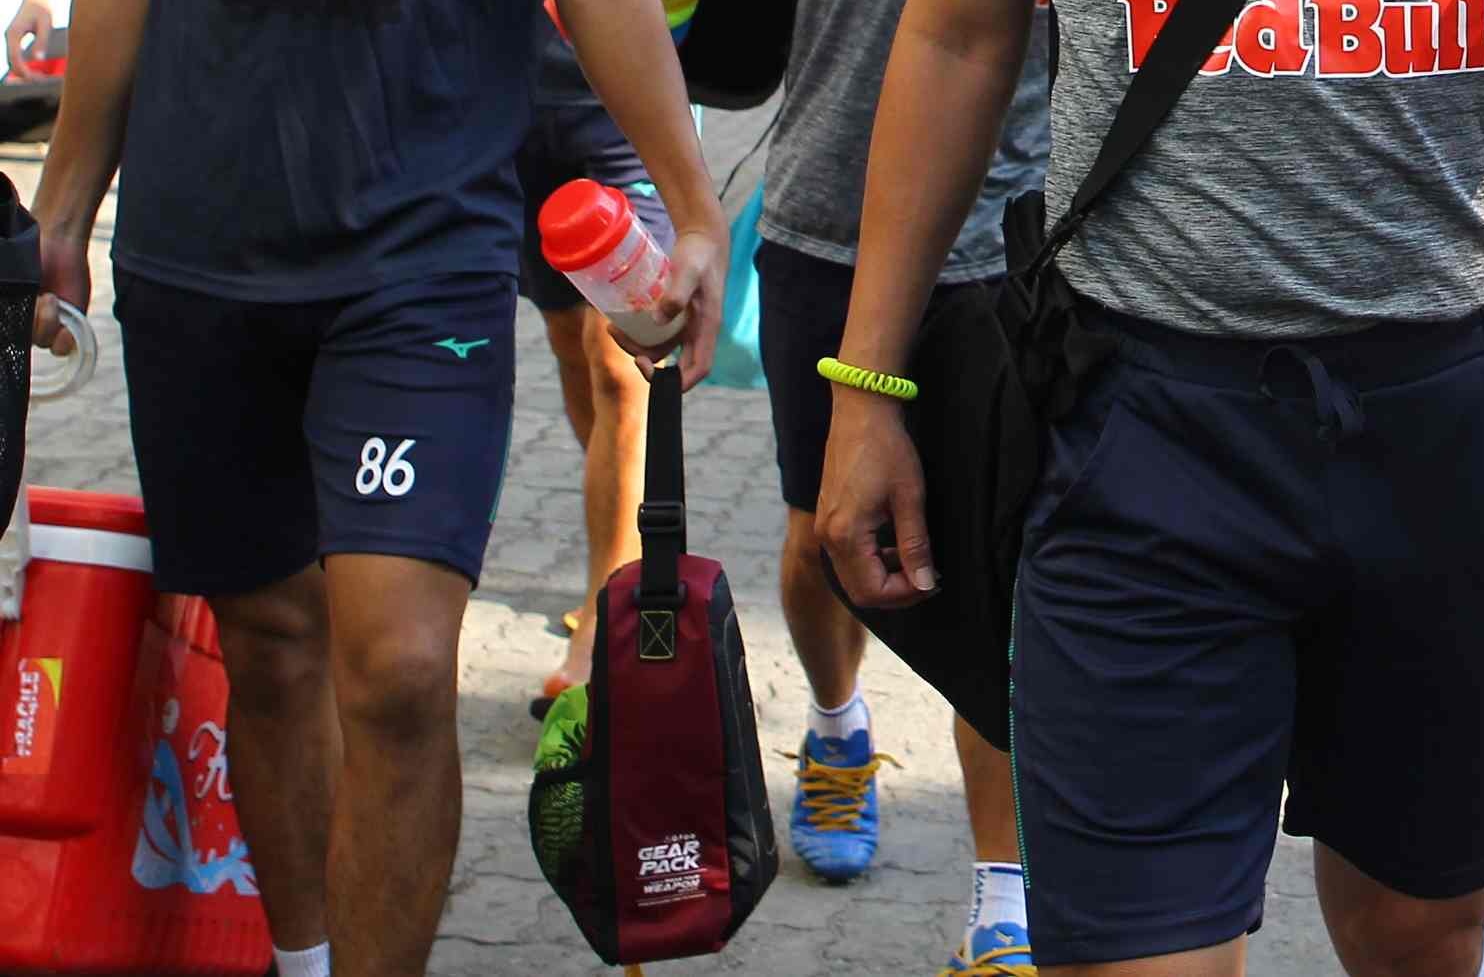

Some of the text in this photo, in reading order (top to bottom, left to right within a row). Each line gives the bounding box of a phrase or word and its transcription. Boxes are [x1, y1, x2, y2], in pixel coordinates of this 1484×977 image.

[355, 436, 417, 497] 86
[14, 670, 41, 758] FRAGILE
[637, 840, 701, 861] GEAR
[639, 853, 701, 876] PACK
